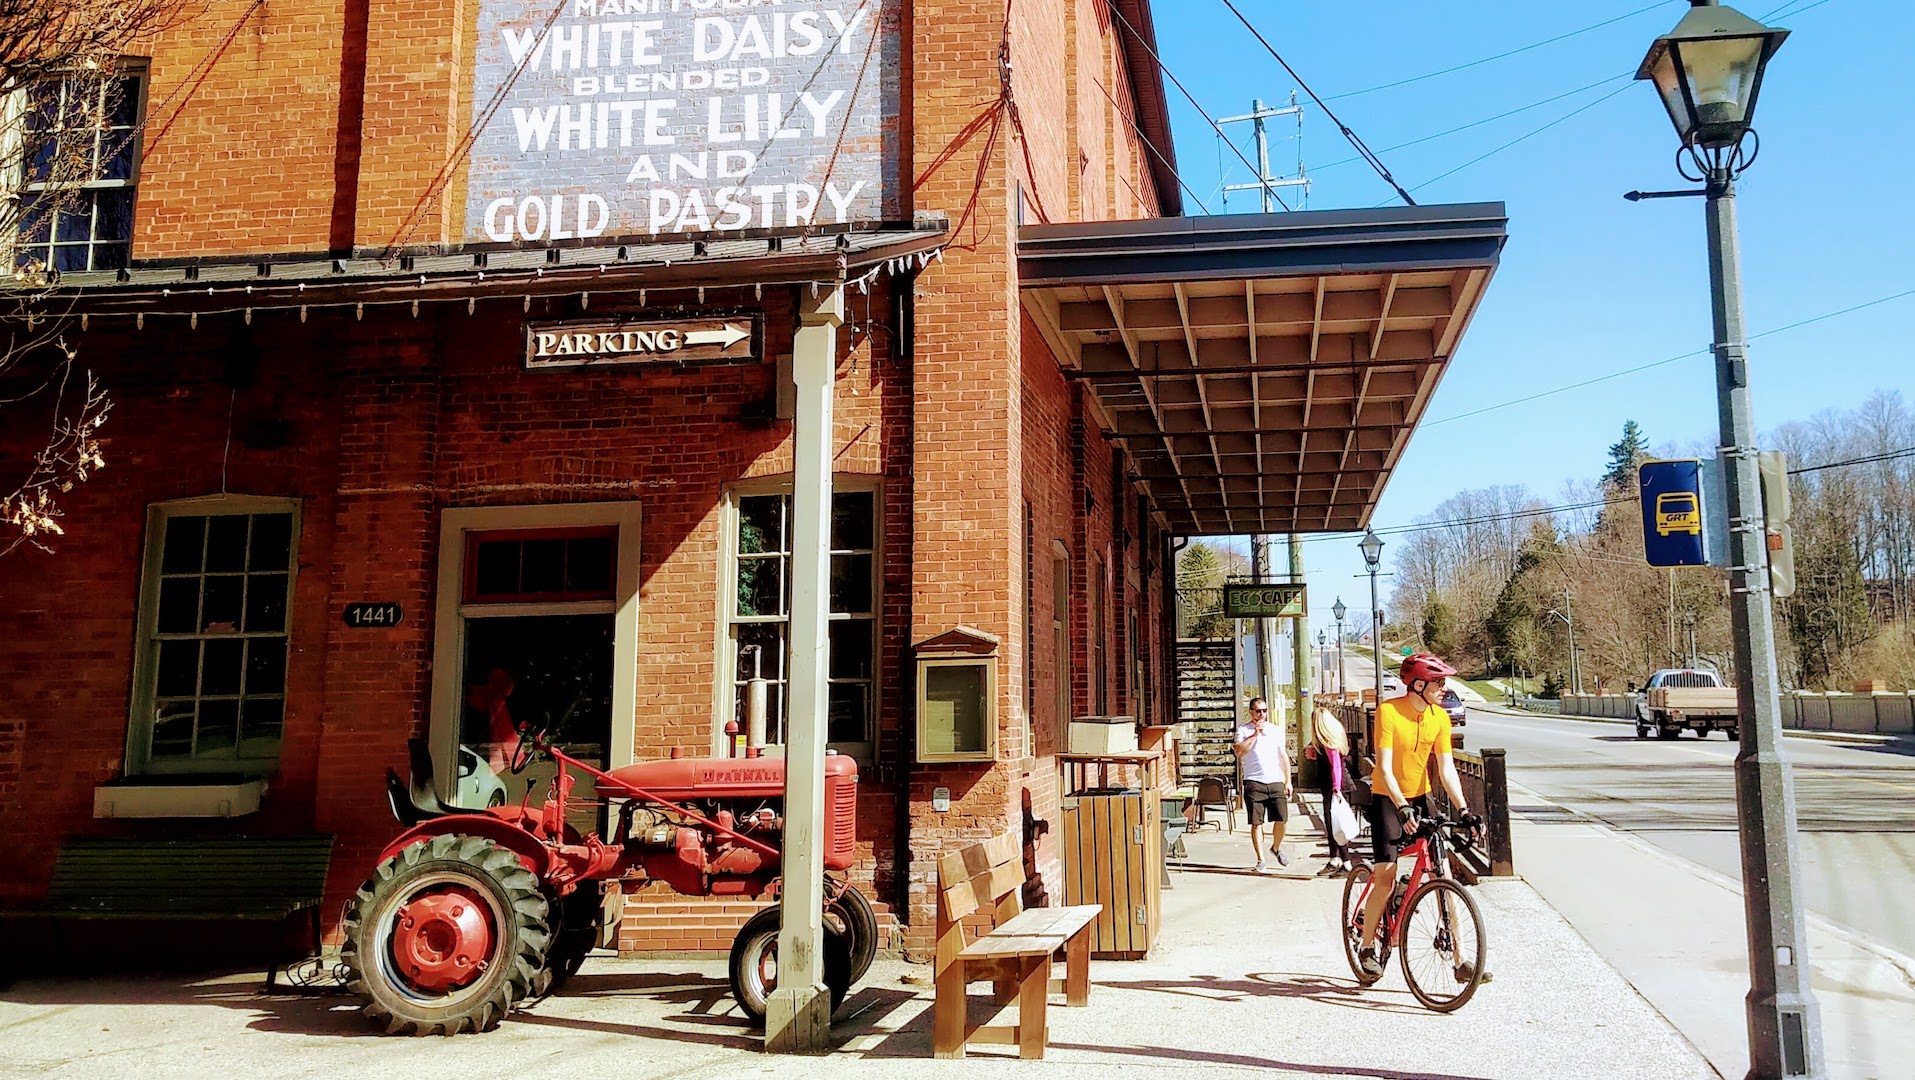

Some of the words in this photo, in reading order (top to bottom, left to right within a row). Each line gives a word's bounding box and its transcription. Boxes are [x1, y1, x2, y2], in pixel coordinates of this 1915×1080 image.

[502, 20, 663, 71] WHITE
[692, 8, 867, 61] DAISY
[574, 67, 770, 96] BLENDED
[511, 99, 676, 152] WHITE
[707, 90, 846, 143] LILY
[626, 150, 756, 183] AND
[483, 193, 610, 242] GOLD
[649, 180, 867, 234] PASTRY
[534, 329, 680, 357] PARKING
[1666, 513, 1689, 521] GRT
[353, 606, 394, 623] 1441
[716, 771, 780, 781] FARMALL
